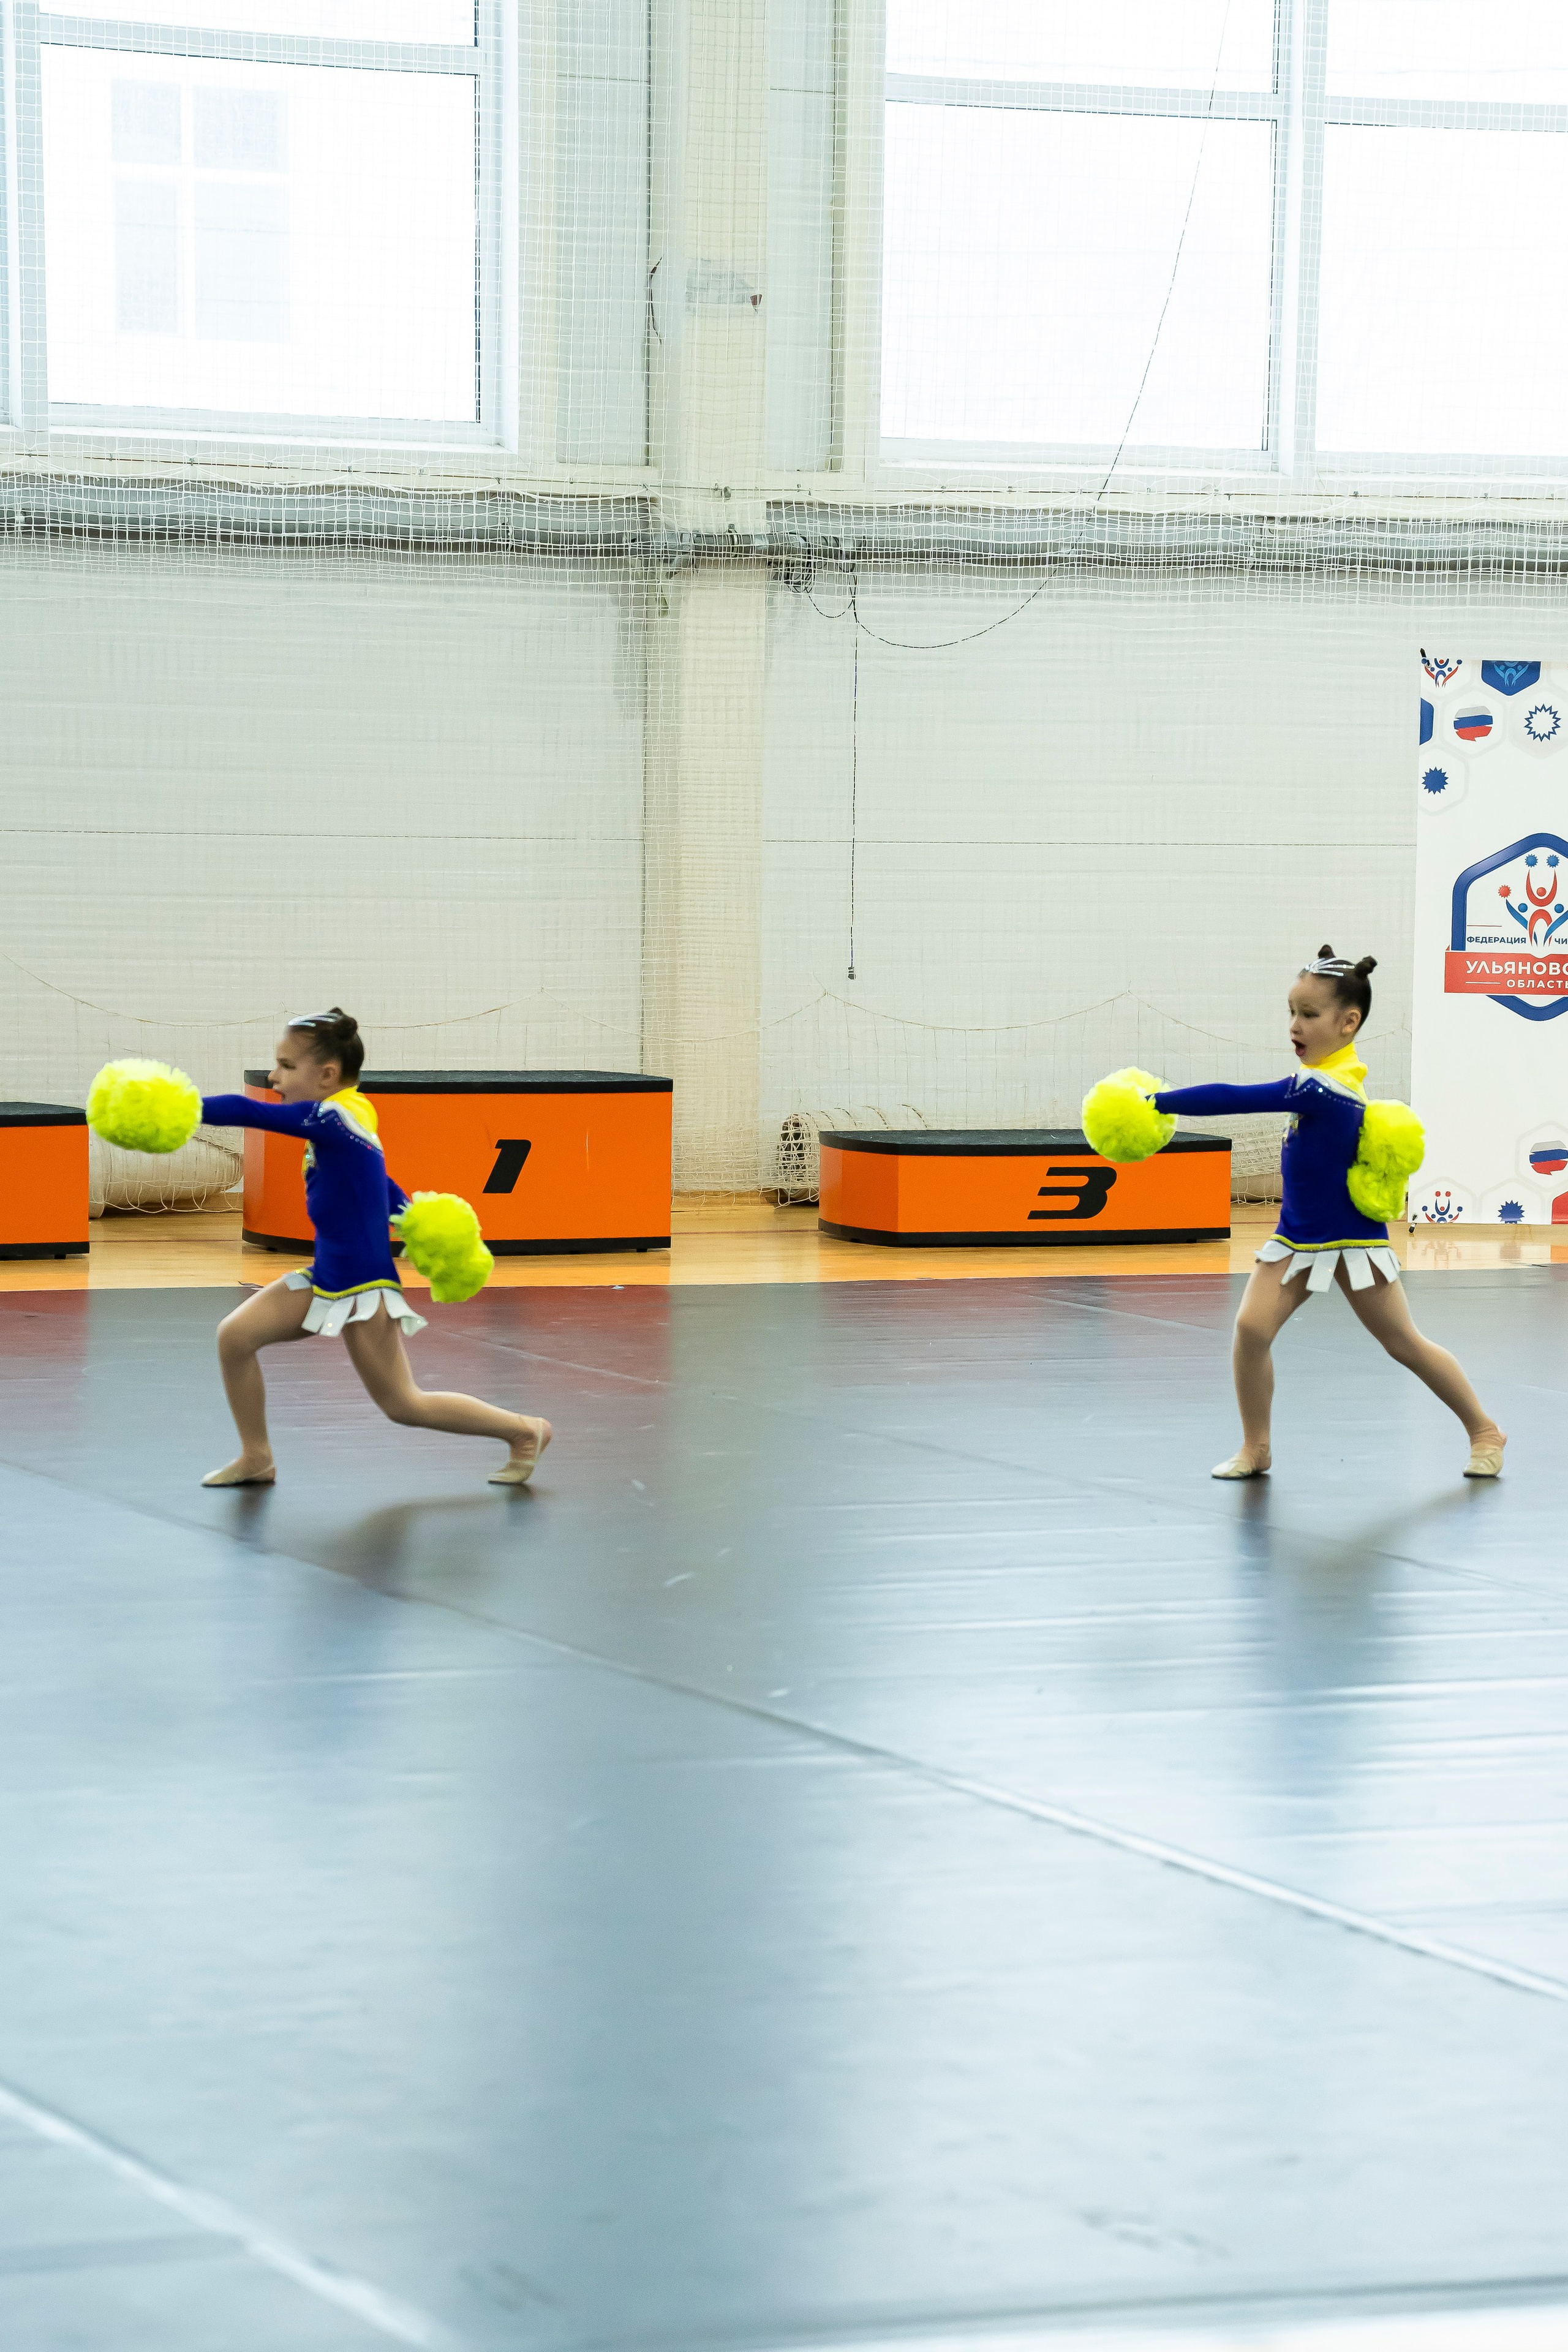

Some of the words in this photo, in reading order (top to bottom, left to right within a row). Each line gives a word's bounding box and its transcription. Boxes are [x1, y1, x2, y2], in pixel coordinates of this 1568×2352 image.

[1466, 936, 1526, 944] ФЕДЕРАЦИЯ
[483, 1139, 532, 1193] 1
[1028, 1166, 1117, 1220] 3
